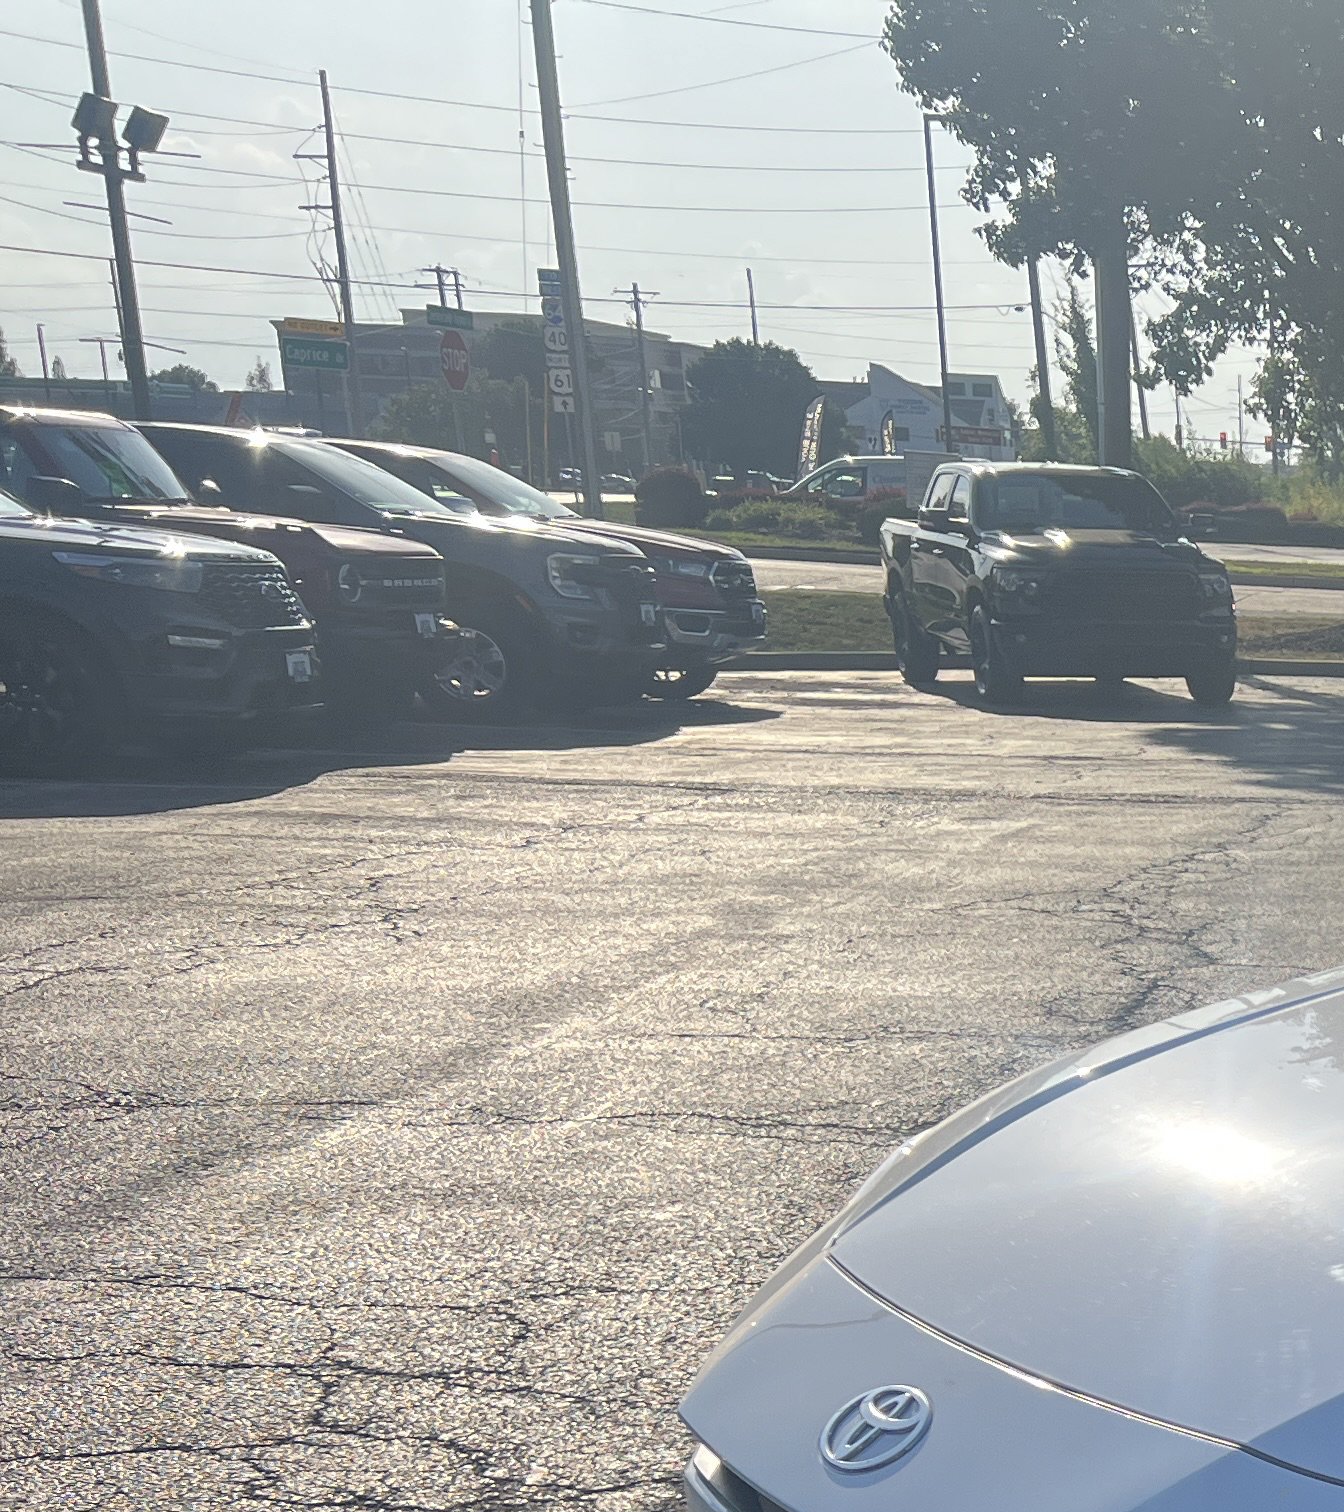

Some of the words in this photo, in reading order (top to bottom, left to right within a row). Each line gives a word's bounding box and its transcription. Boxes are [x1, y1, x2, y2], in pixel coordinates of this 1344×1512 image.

[549, 331, 566, 346] 40
[287, 345, 328, 362] Caprice
[442, 348, 467, 371] STOP
[555, 374, 571, 388] 61
